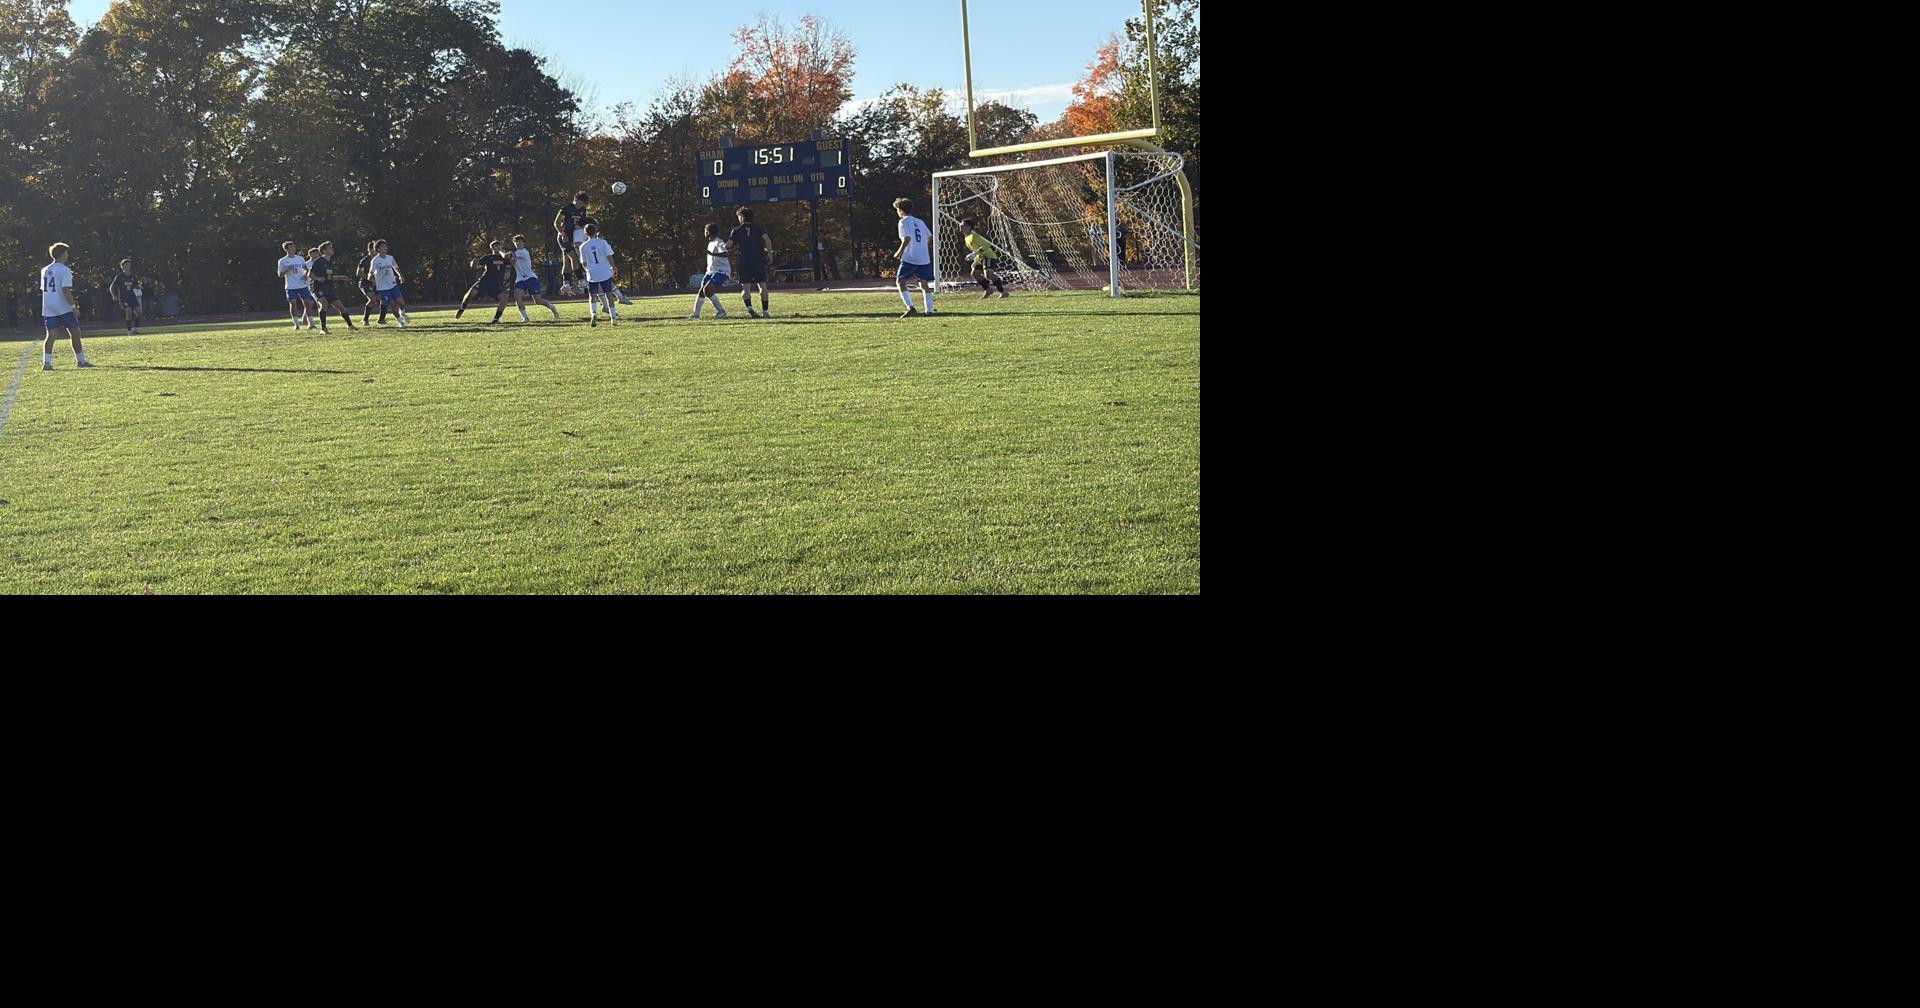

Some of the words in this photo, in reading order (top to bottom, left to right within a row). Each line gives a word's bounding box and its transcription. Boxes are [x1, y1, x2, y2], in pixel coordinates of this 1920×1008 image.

[816, 140, 843, 151] GUEST
[754, 146, 794, 165] 15:51
[838, 150, 842, 165] 1
[713, 159, 723, 176] 0
[717, 179, 739, 189] DOWN
[748, 178, 757, 187] TO
[773, 175, 792, 185] BALL
[793, 174, 804, 183] ON
[838, 176, 846, 188] 0
[702, 186, 710, 198] 0
[819, 183, 823, 195] 1
[914, 228, 922, 243] 6
[592, 251, 599, 264] 1
[43, 276, 56, 293] 14
